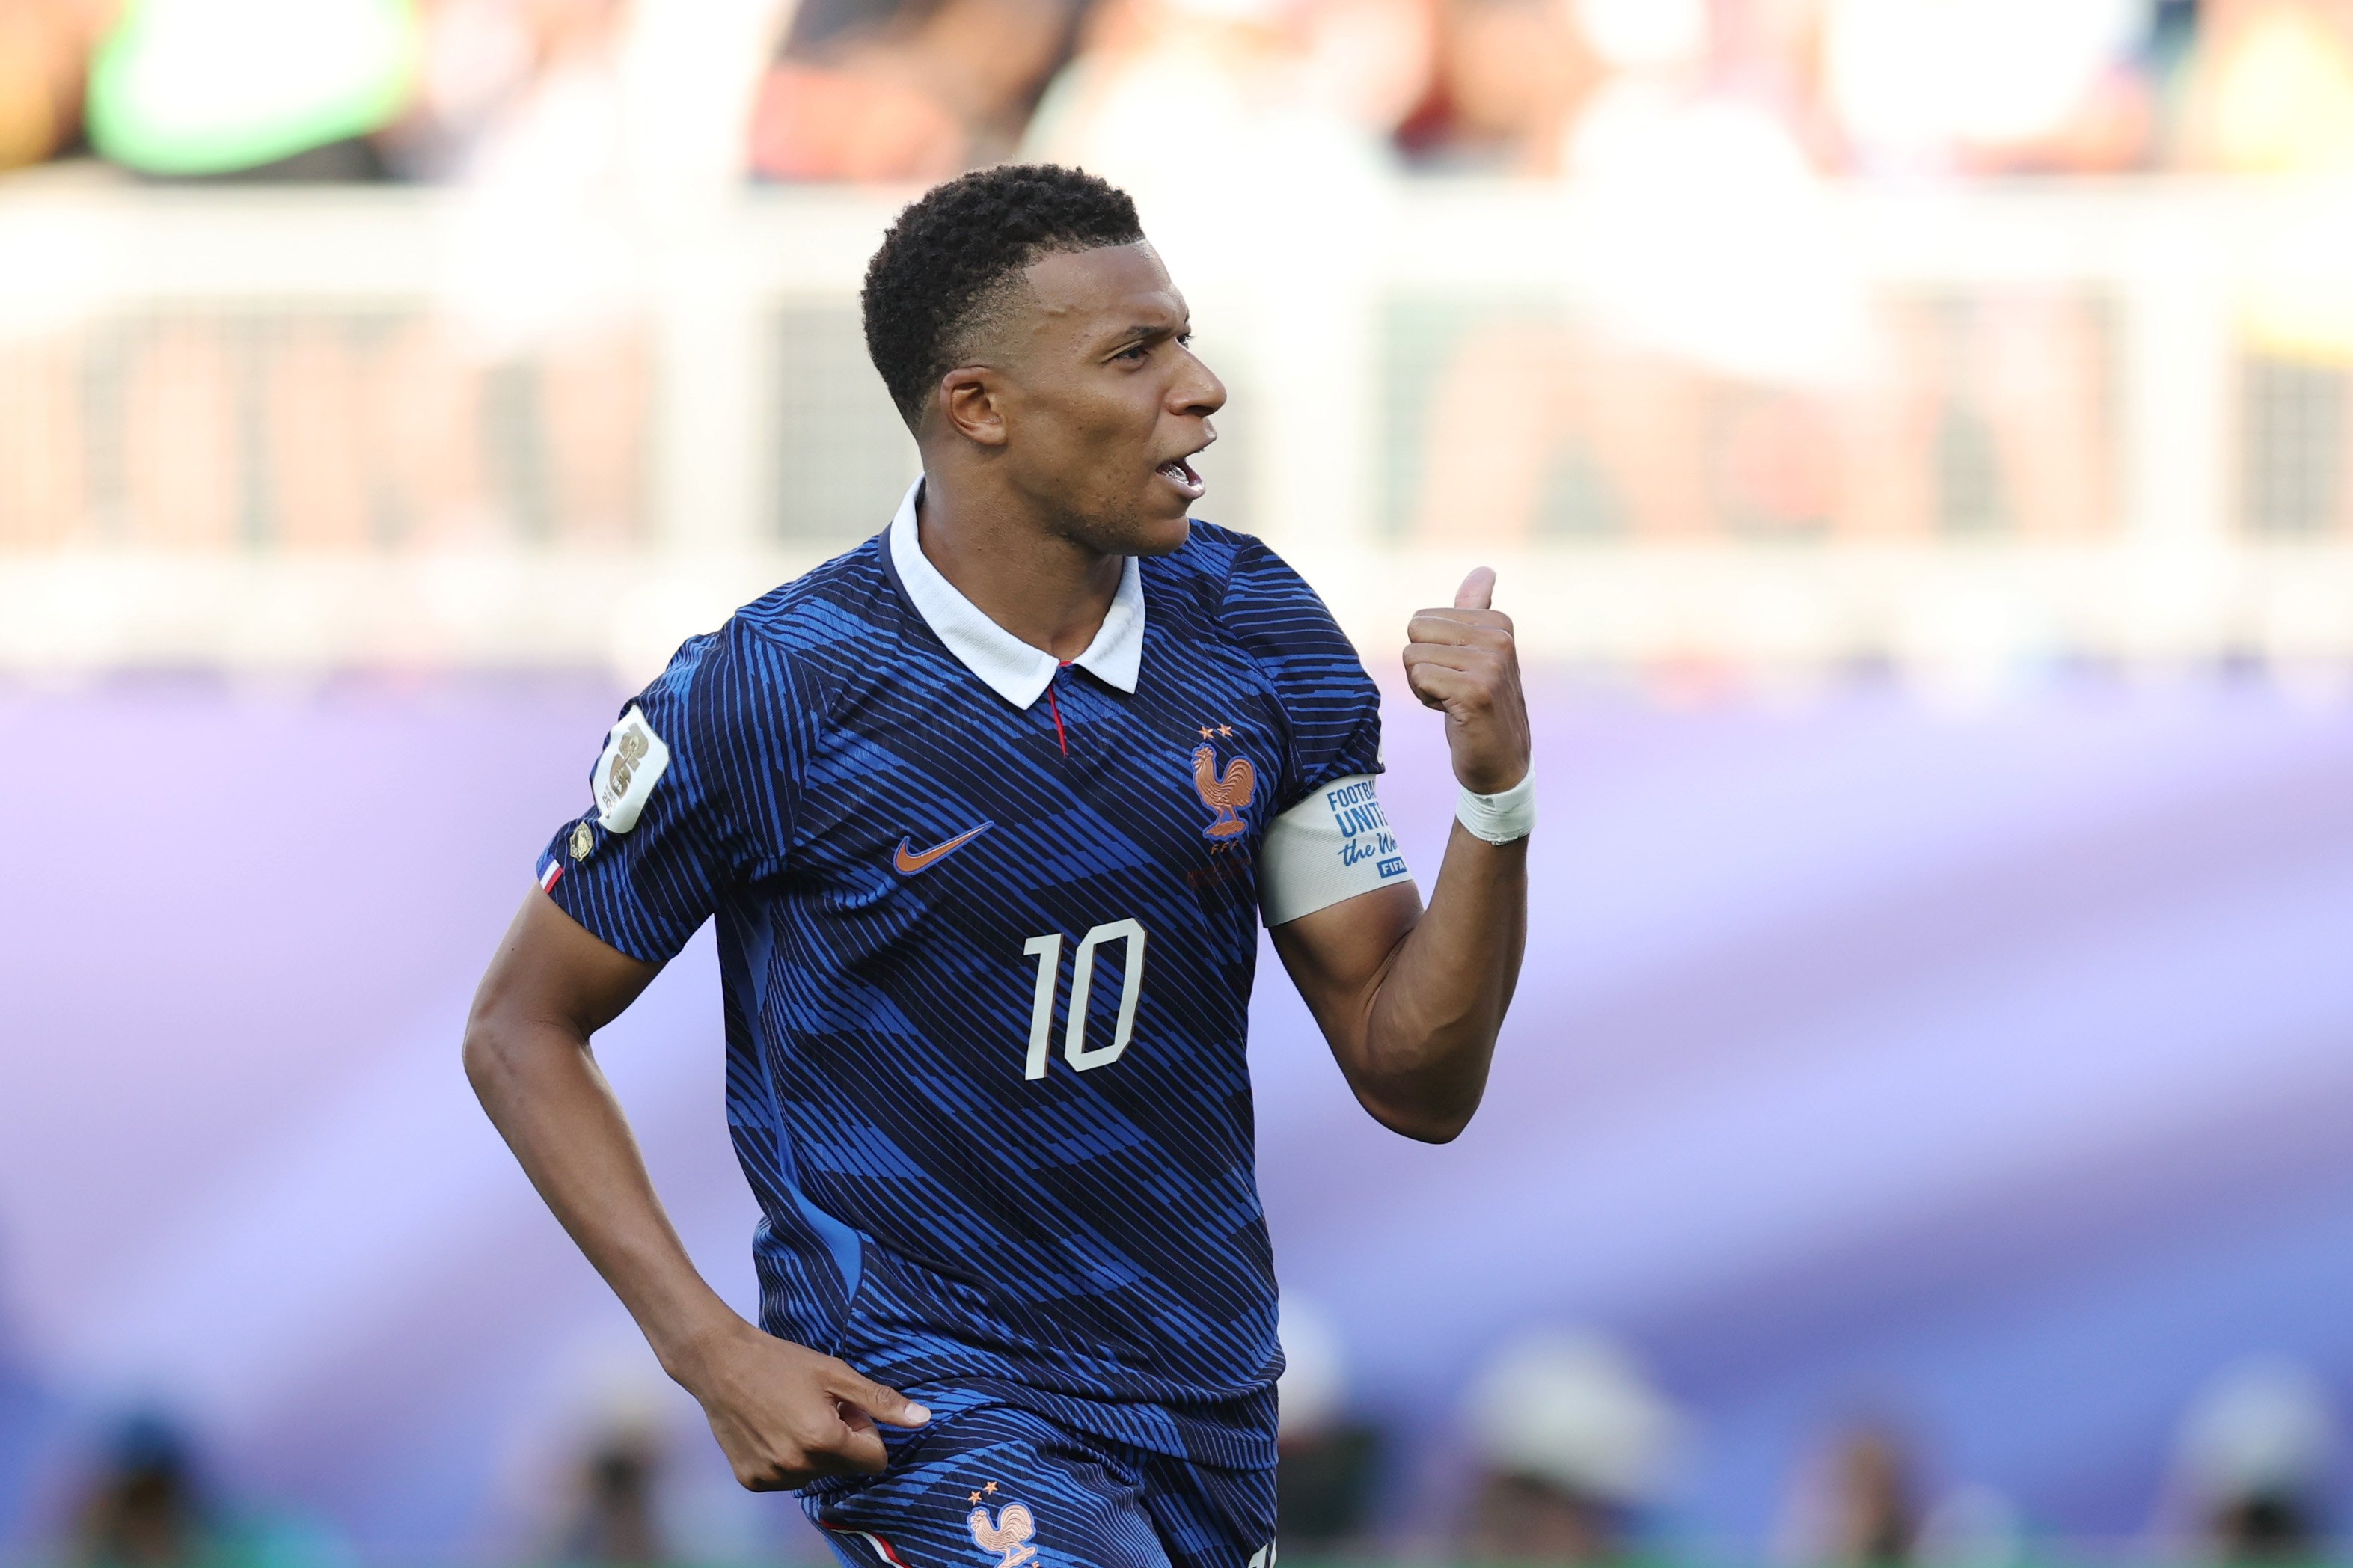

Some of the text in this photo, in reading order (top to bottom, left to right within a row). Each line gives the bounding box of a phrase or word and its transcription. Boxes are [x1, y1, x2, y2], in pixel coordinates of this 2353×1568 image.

[1327, 780, 1377, 812] FOOTBA
[1337, 831, 1398, 866] the Wo
[1381, 858, 1405, 875] FIFA
[1023, 918, 1148, 1081] 10
